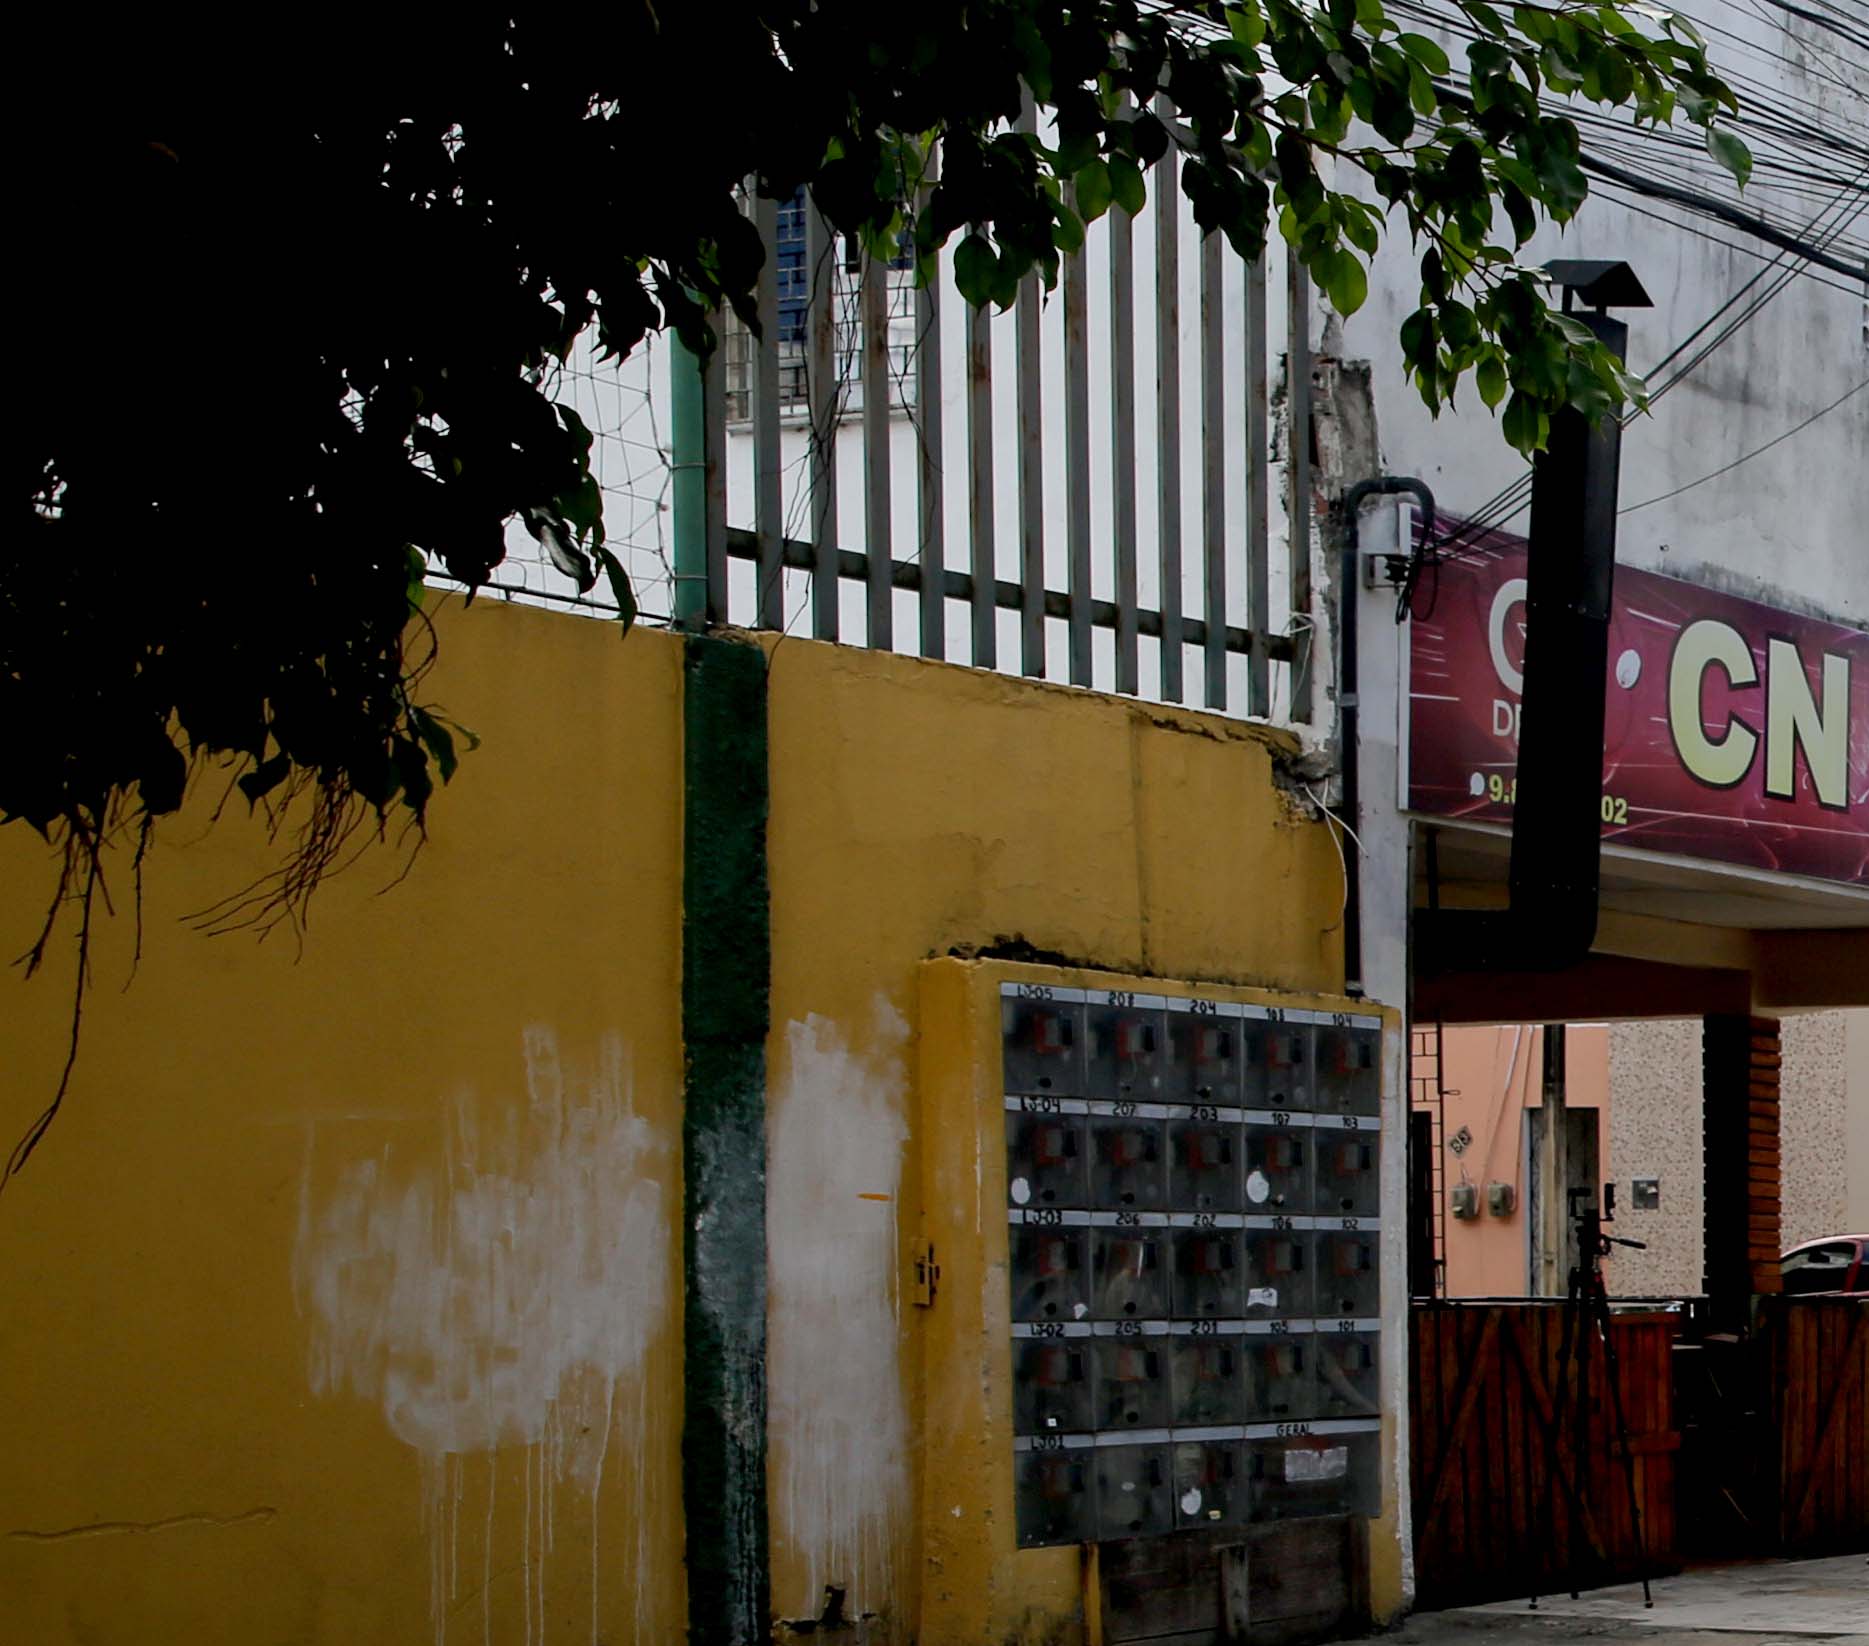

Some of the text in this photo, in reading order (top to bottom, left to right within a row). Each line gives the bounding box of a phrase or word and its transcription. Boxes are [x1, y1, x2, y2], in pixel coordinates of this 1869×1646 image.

[1668, 612, 1850, 812] CN
[1190, 999, 1217, 1014] 204
[1332, 1013, 1353, 1026] 104
[1113, 1103, 1137, 1117] 207
[1191, 1106, 1218, 1121] 203
[1272, 1113, 1290, 1126] 107
[1115, 1213, 1140, 1226] 206
[1192, 1214, 1217, 1227] 202
[1115, 1321, 1142, 1335] 205
[1190, 1320, 1218, 1335] 201
